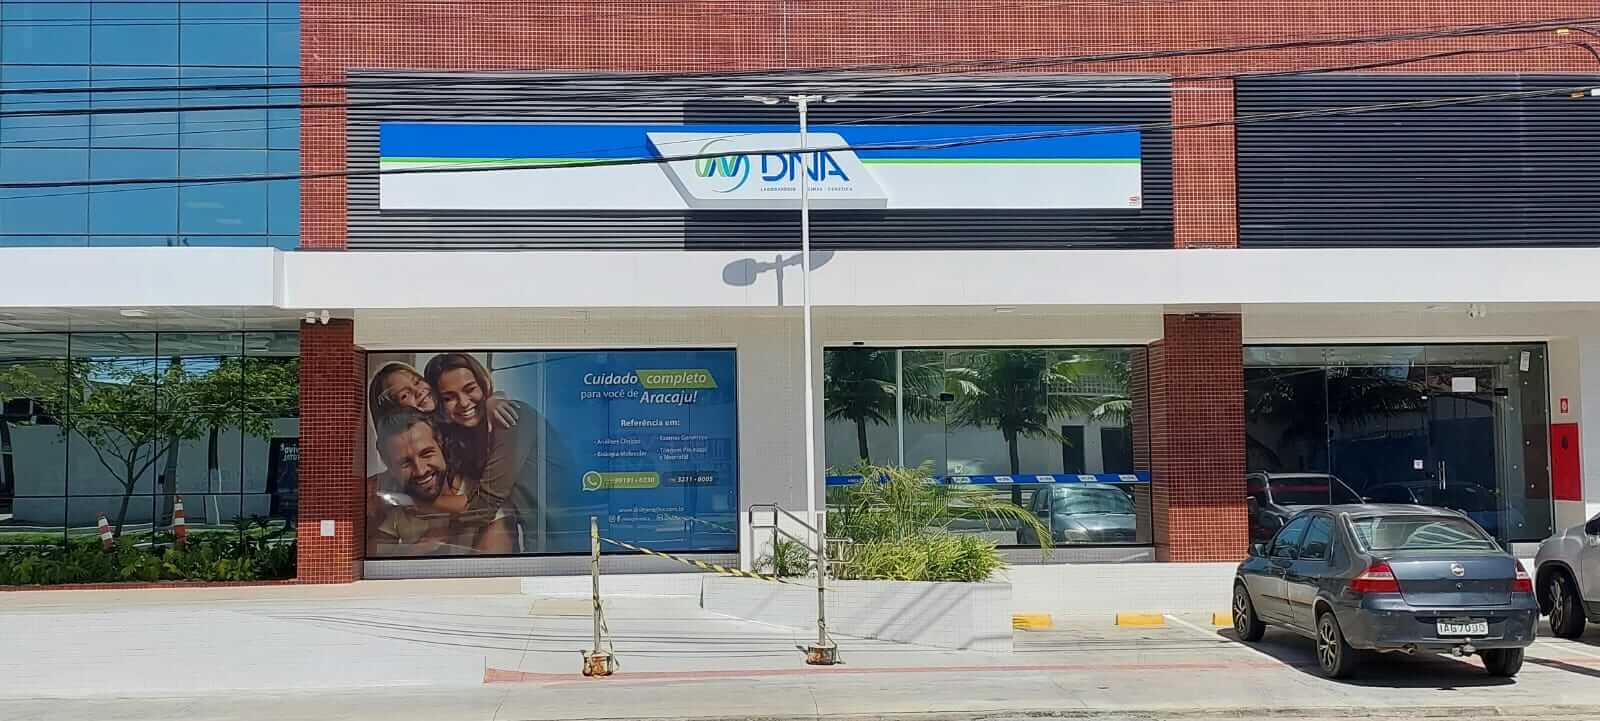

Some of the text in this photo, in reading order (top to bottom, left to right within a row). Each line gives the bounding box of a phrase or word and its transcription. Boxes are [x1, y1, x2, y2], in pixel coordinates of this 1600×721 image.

[761, 151, 850, 182] DNA
[583, 372, 707, 386] Cuidado completo
[580, 387, 698, 405] para você de Aracaju!
[620, 418, 680, 428] Referência em:
